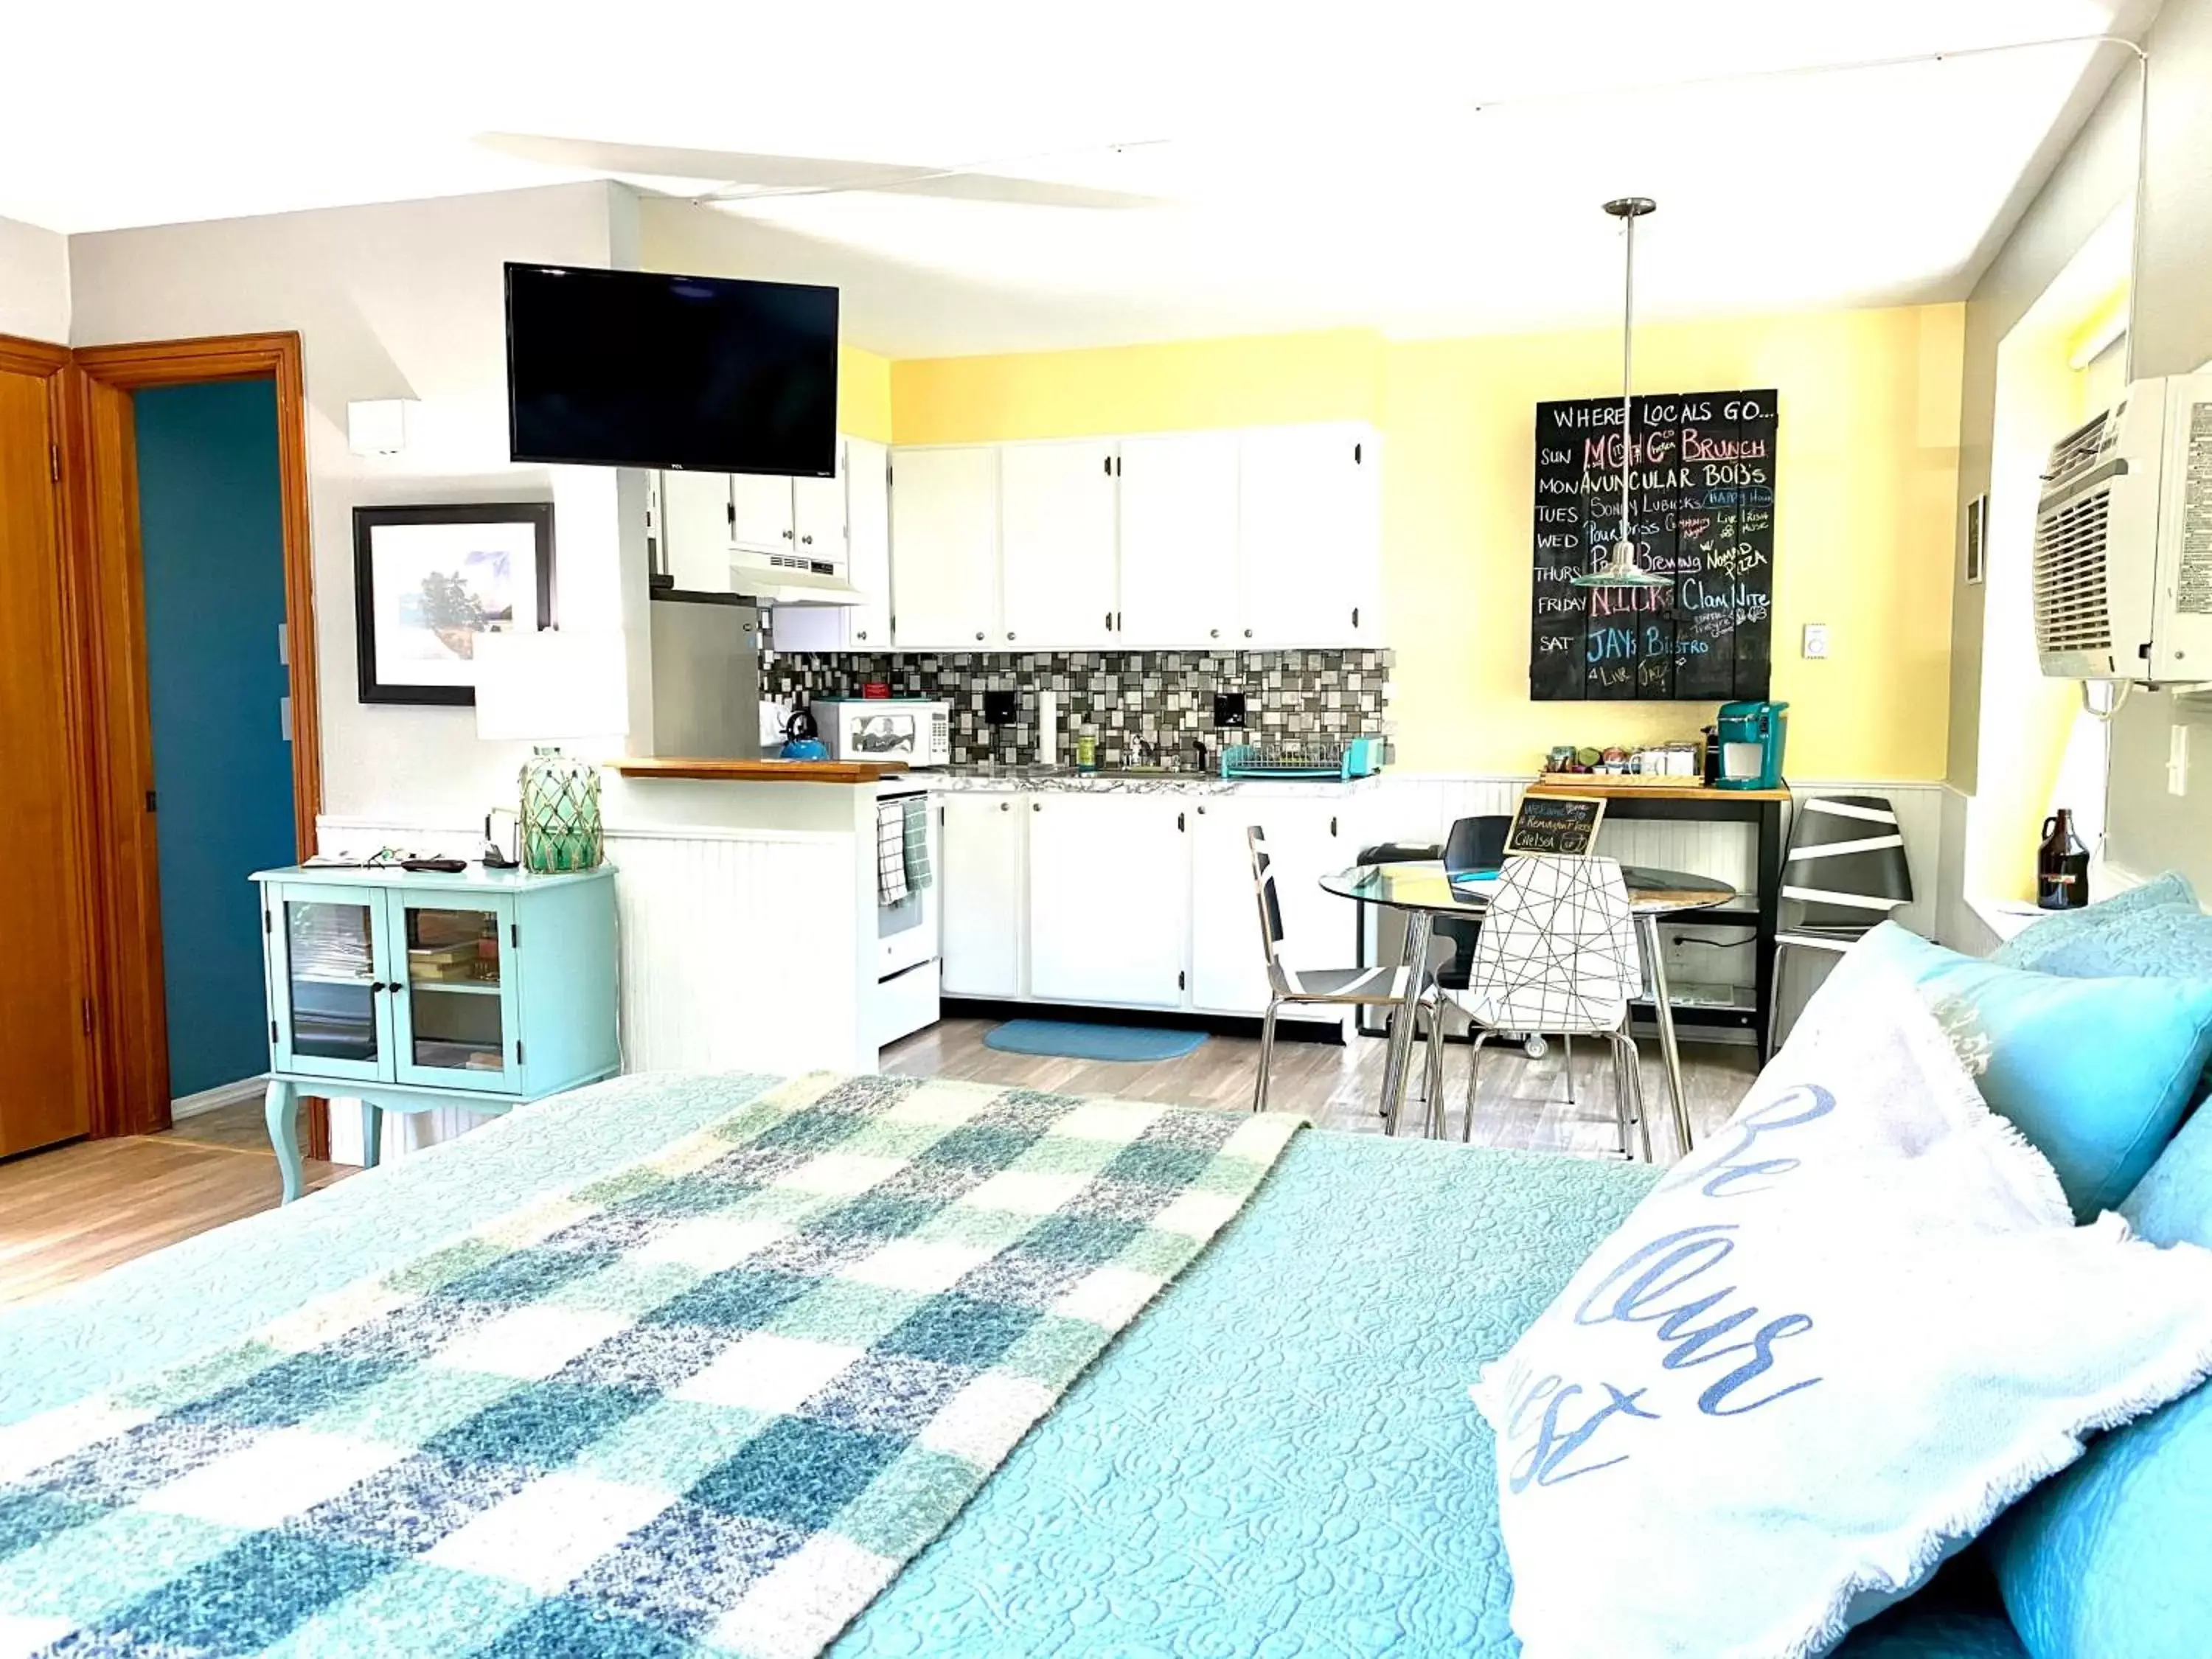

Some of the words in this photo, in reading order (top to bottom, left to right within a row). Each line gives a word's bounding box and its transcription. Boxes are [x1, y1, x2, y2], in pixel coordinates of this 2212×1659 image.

[1554, 406, 1625, 428] WHERE
[1644, 402, 1712, 426] LOCALS
[1682, 428, 1766, 462] BRUNCH
[1541, 448, 1571, 465] SUN
[1540, 479, 1579, 494] MON
[1535, 505, 1579, 523] TUES
[1537, 533, 1579, 549] WED
[1534, 566, 1582, 582] THURS
[1539, 597, 1587, 614] FRIDAY
[1540, 636, 1574, 652] SAT
